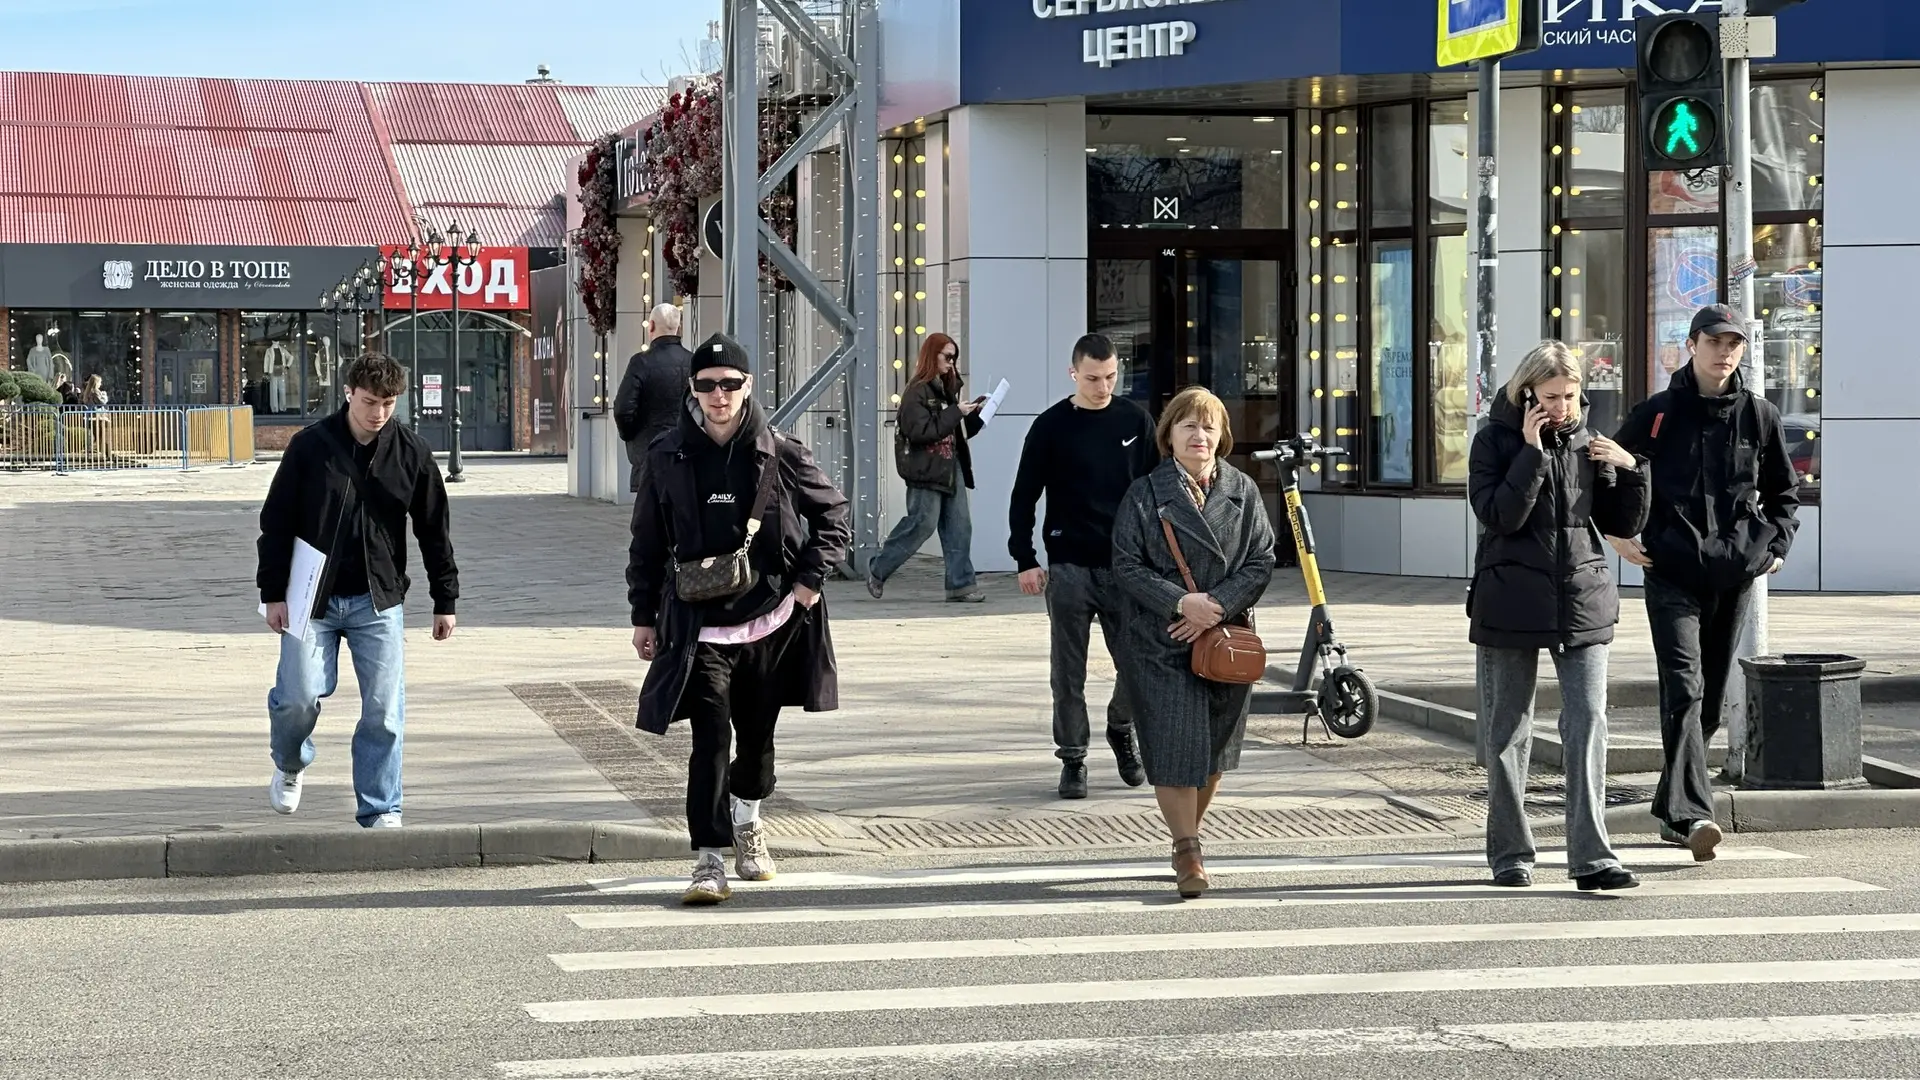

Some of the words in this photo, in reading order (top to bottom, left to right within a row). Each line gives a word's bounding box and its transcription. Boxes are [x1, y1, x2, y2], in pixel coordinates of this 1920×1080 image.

[1083, 20, 1195, 67] ЦЕНТР
[1544, 28, 1591, 46] СКИЙ
[144, 260, 204, 281] ДЕЛО
[210, 260, 225, 279] В
[229, 260, 291, 279] ТОПЕ
[160, 281, 201, 289] женская
[203, 281, 239, 290] одежда
[391, 258, 519, 303] ВХОД
[1287, 495, 1305, 550] WHOOSH
